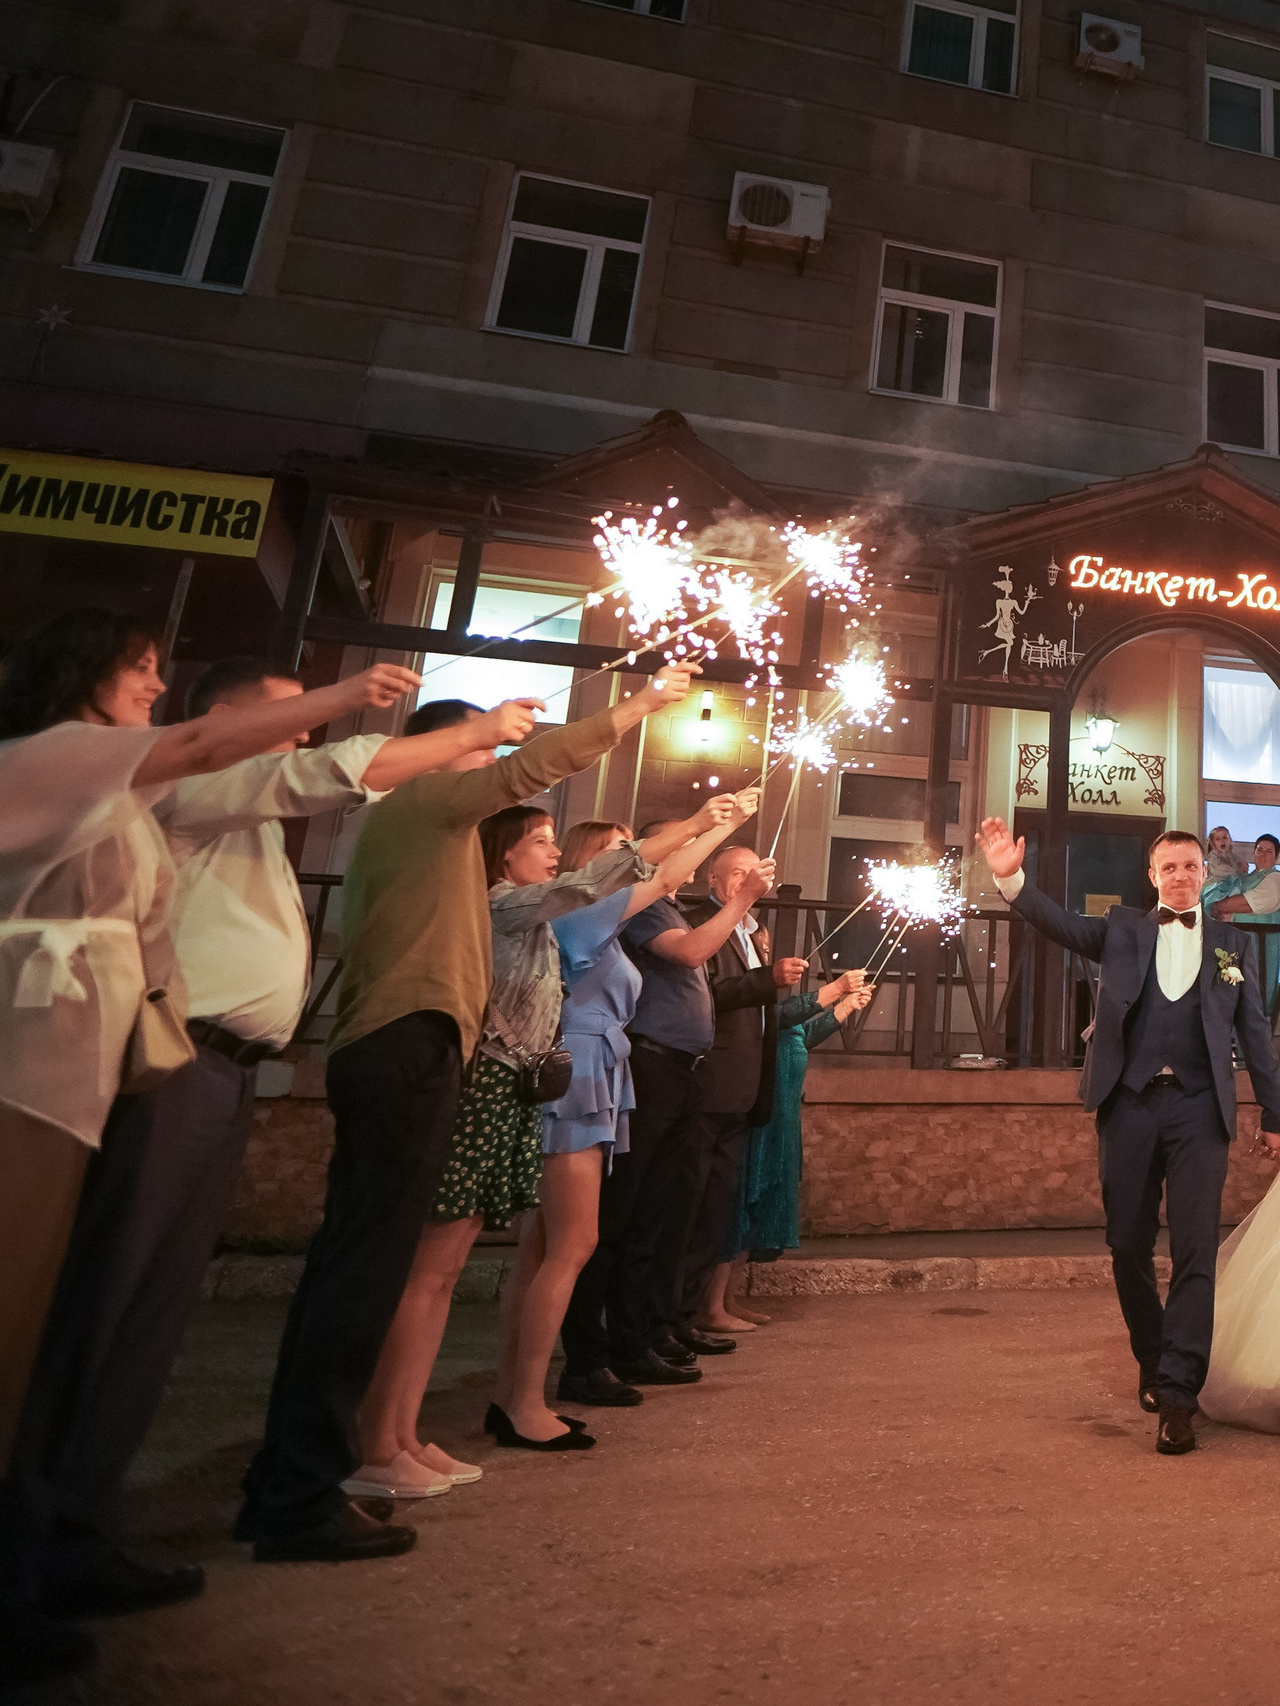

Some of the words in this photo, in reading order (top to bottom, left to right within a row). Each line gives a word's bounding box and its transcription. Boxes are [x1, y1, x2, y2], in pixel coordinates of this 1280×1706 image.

[0, 463, 262, 540] имчистка
[1069, 763, 1137, 785] анкет
[1068, 781, 1121, 805] Холл
